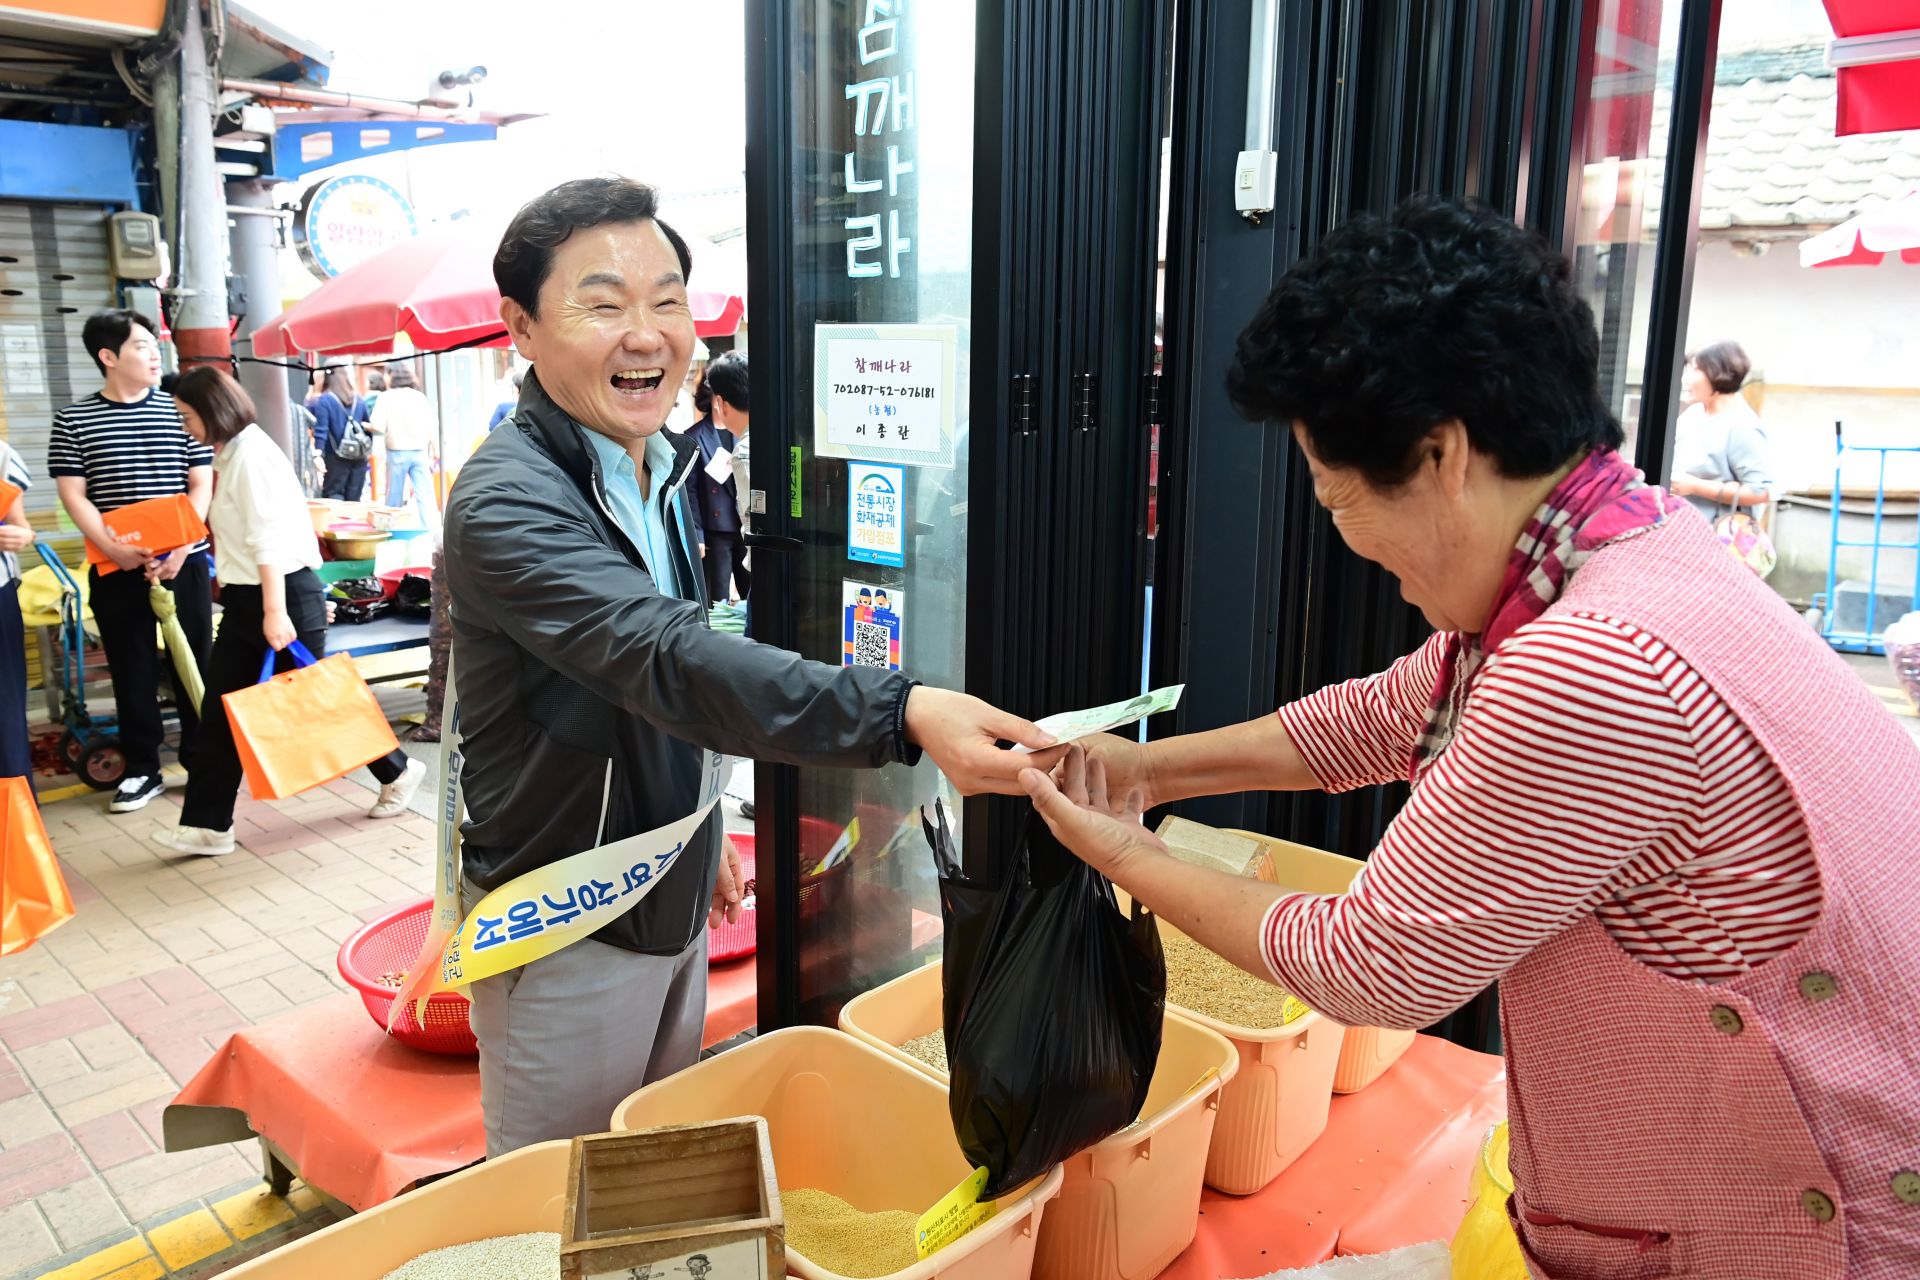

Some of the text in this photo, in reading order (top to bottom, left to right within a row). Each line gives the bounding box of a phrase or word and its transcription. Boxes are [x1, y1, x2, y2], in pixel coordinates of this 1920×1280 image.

[855, 357, 912, 374] 참깨나라
[833, 384, 935, 399] 702087-52-076181
[856, 493, 896, 512] 전통시장
[856, 510, 895, 528] 화재공제
